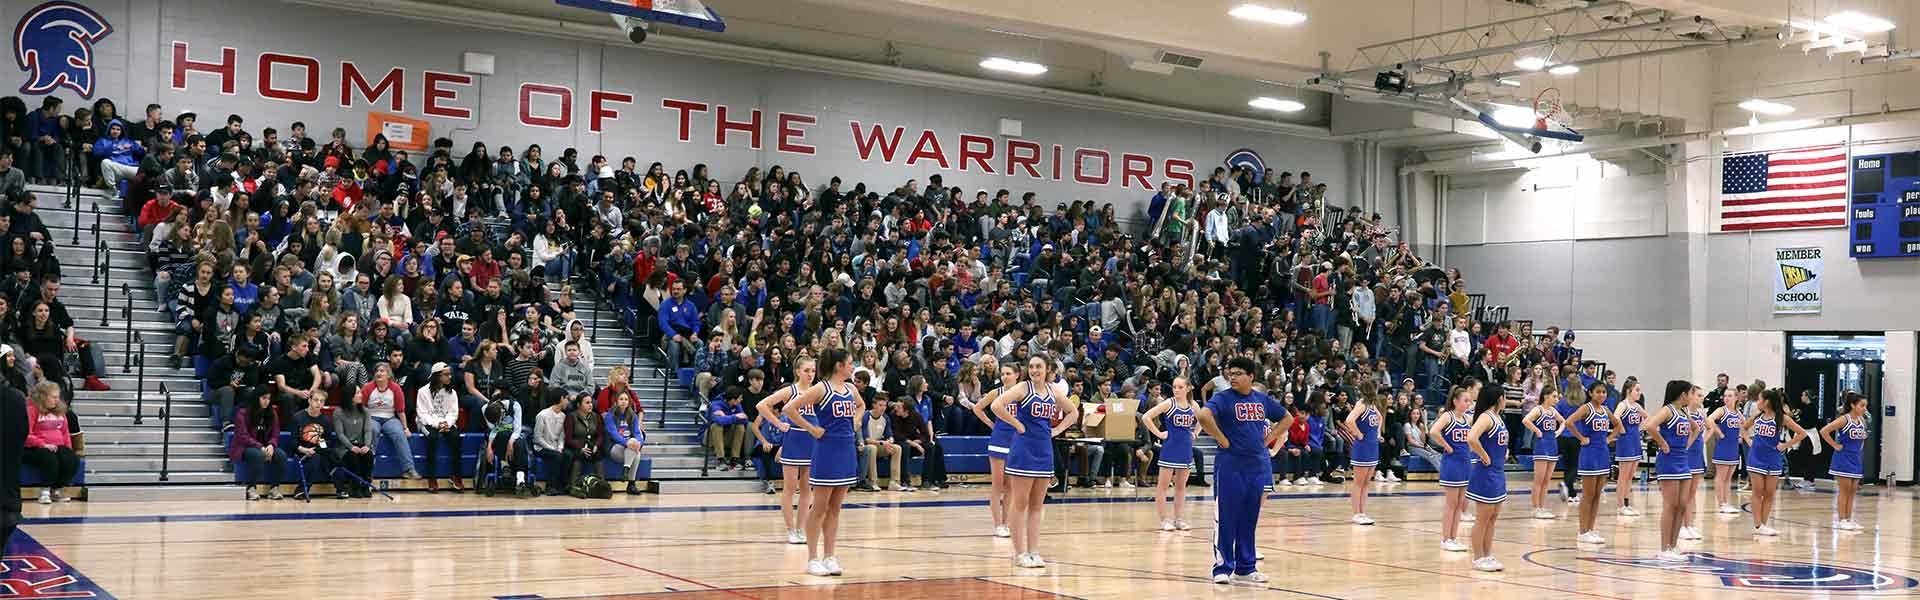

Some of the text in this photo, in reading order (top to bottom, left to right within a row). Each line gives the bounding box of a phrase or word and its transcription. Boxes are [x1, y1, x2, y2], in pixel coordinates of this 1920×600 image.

[171, 40, 1195, 191] HOME OF THE WARRIORS
[1858, 159, 1881, 169] Home
[1855, 209, 1874, 219] fouls
[1856, 245, 1872, 253] won
[1776, 249, 1821, 260] MEMBER
[1776, 292, 1819, 302] SCHOOL
[1235, 402, 1264, 421] CHS
